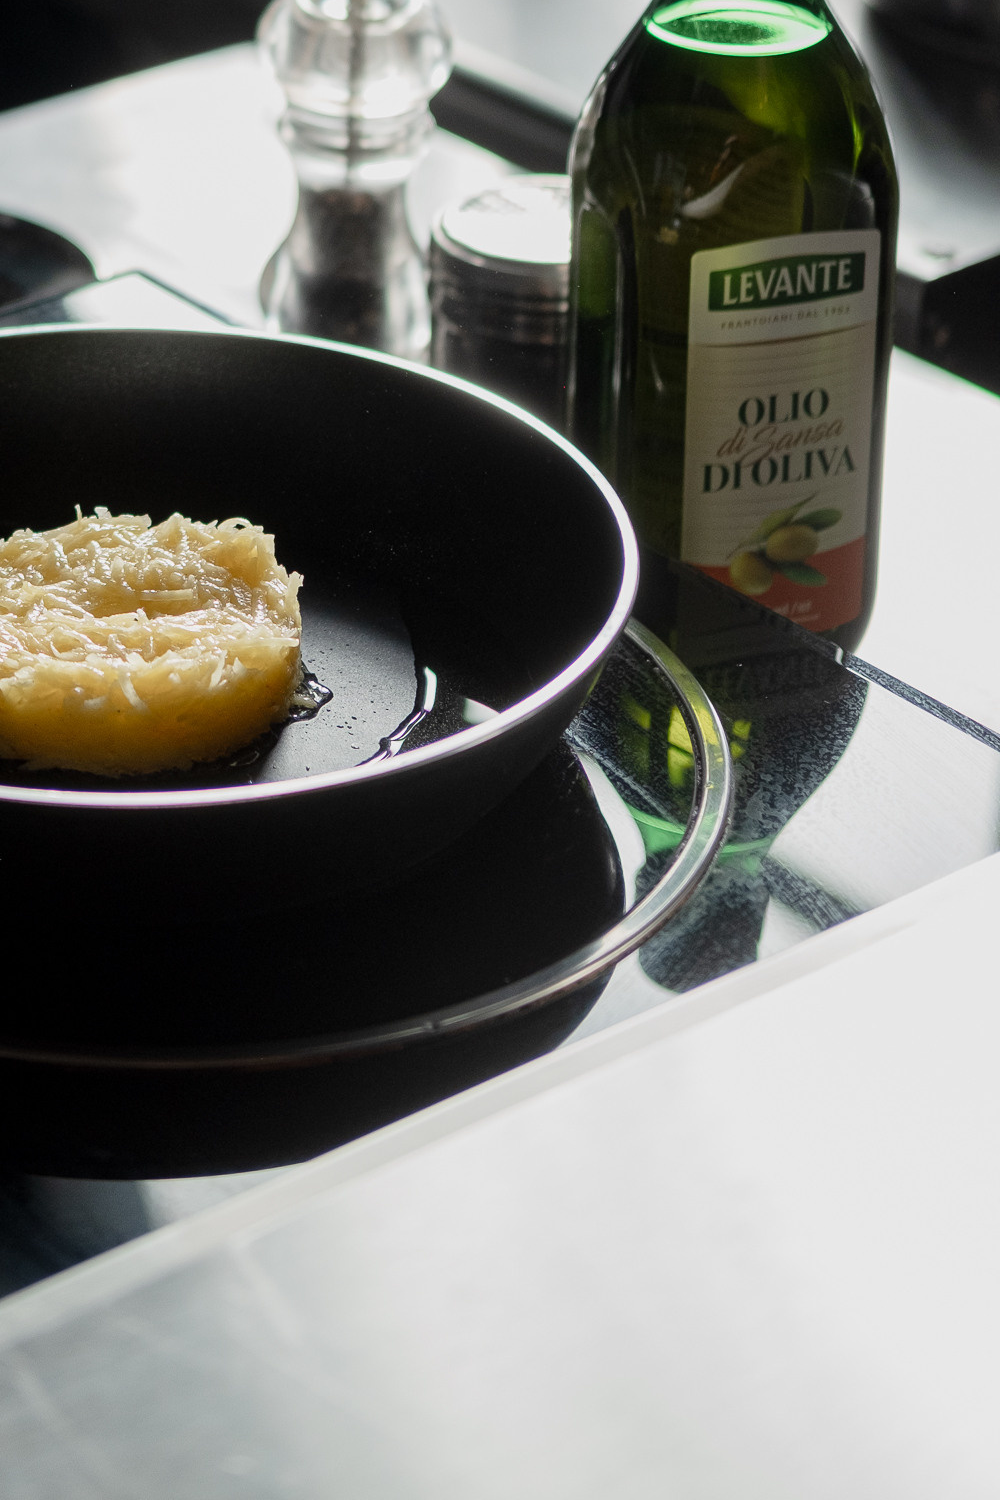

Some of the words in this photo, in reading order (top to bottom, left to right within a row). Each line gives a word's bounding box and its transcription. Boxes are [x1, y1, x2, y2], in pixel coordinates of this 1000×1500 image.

[722, 258, 853, 306] LEVANTE
[738, 387, 830, 428] OLIO
[716, 427, 748, 458] di
[740, 419, 843, 469] Sansa
[702, 460, 742, 493] DI
[751, 445, 856, 487] OLIVA
